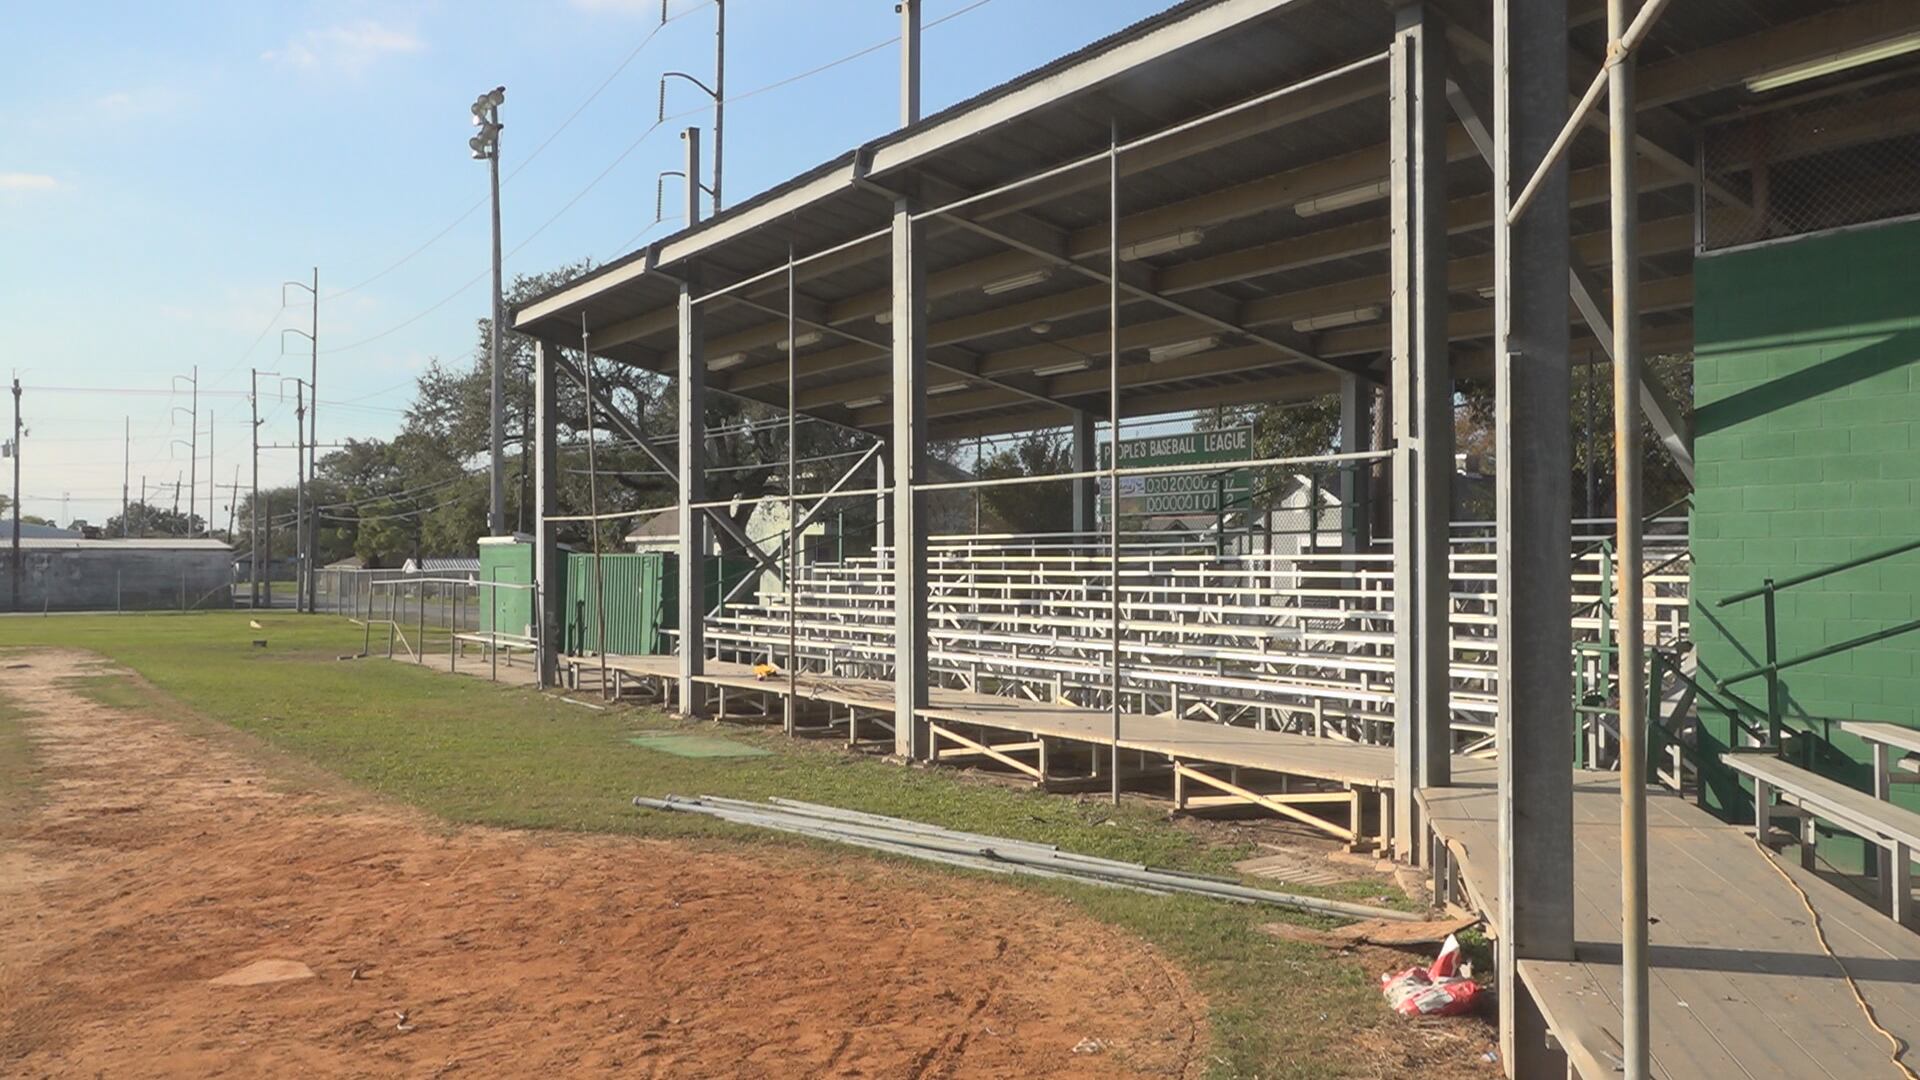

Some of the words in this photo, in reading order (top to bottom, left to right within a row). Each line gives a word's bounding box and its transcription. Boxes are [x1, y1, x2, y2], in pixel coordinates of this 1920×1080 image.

[1104, 440, 1146, 460] POPLE'S
[1150, 436, 1196, 457] BASEBALL
[1204, 431, 1246, 452] LEAGUE
